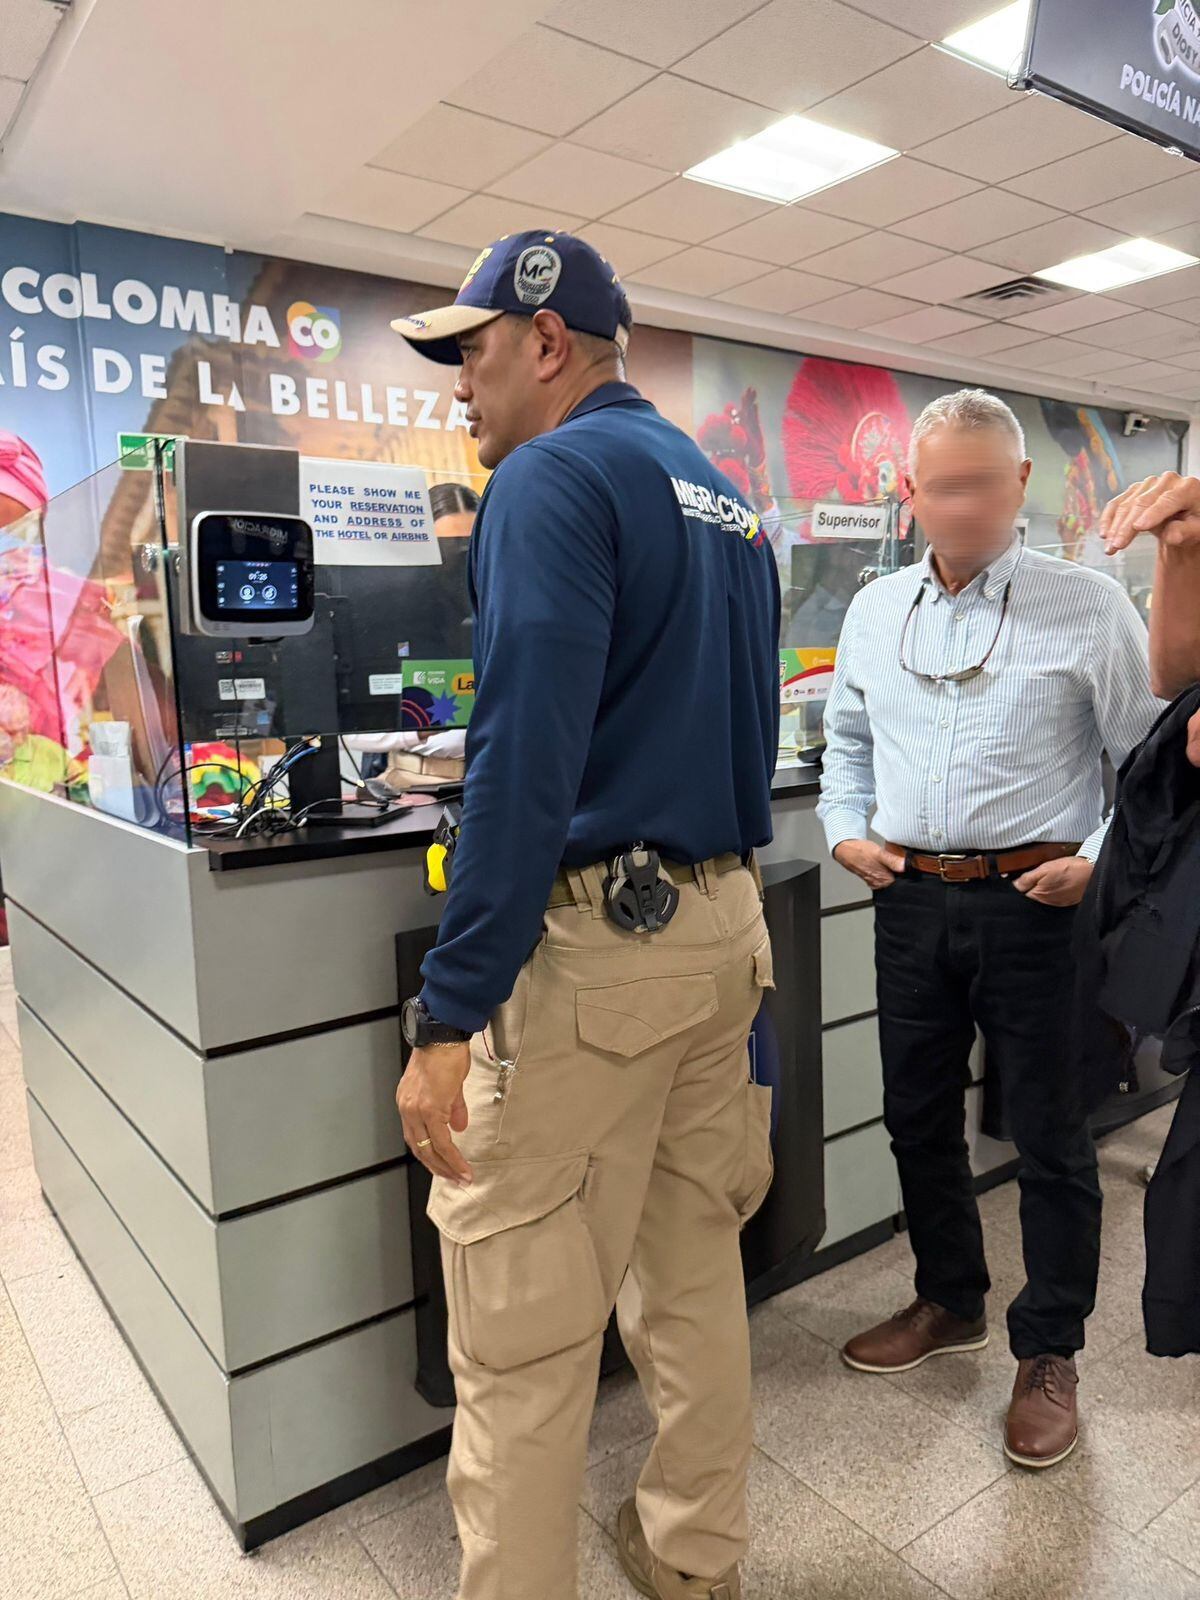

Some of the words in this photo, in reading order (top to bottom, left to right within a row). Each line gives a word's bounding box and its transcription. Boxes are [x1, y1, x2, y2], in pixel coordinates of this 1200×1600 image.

[1120, 64, 1180, 116] POLICÍA
[289, 315, 340, 349] CO
[0, 326, 70, 391] ÍS
[92, 347, 168, 399] DE
[269, 373, 472, 432] BELLEZA
[309, 483, 356, 495] PLEASE
[363, 487, 397, 498] SHOW
[404, 490, 422, 500] ME
[311, 499, 343, 509] YOUR
[350, 501, 424, 514] RESERVATION
[314, 514, 338, 524] AND
[347, 516, 403, 527] ADDRESS
[410, 518, 425, 528] OF
[817, 511, 881, 530] Supervisor
[315, 529, 335, 538] THE
[337, 530, 371, 540] HOTEL
[374, 531, 388, 540] OR
[391, 532, 429, 541] AIRBNB
